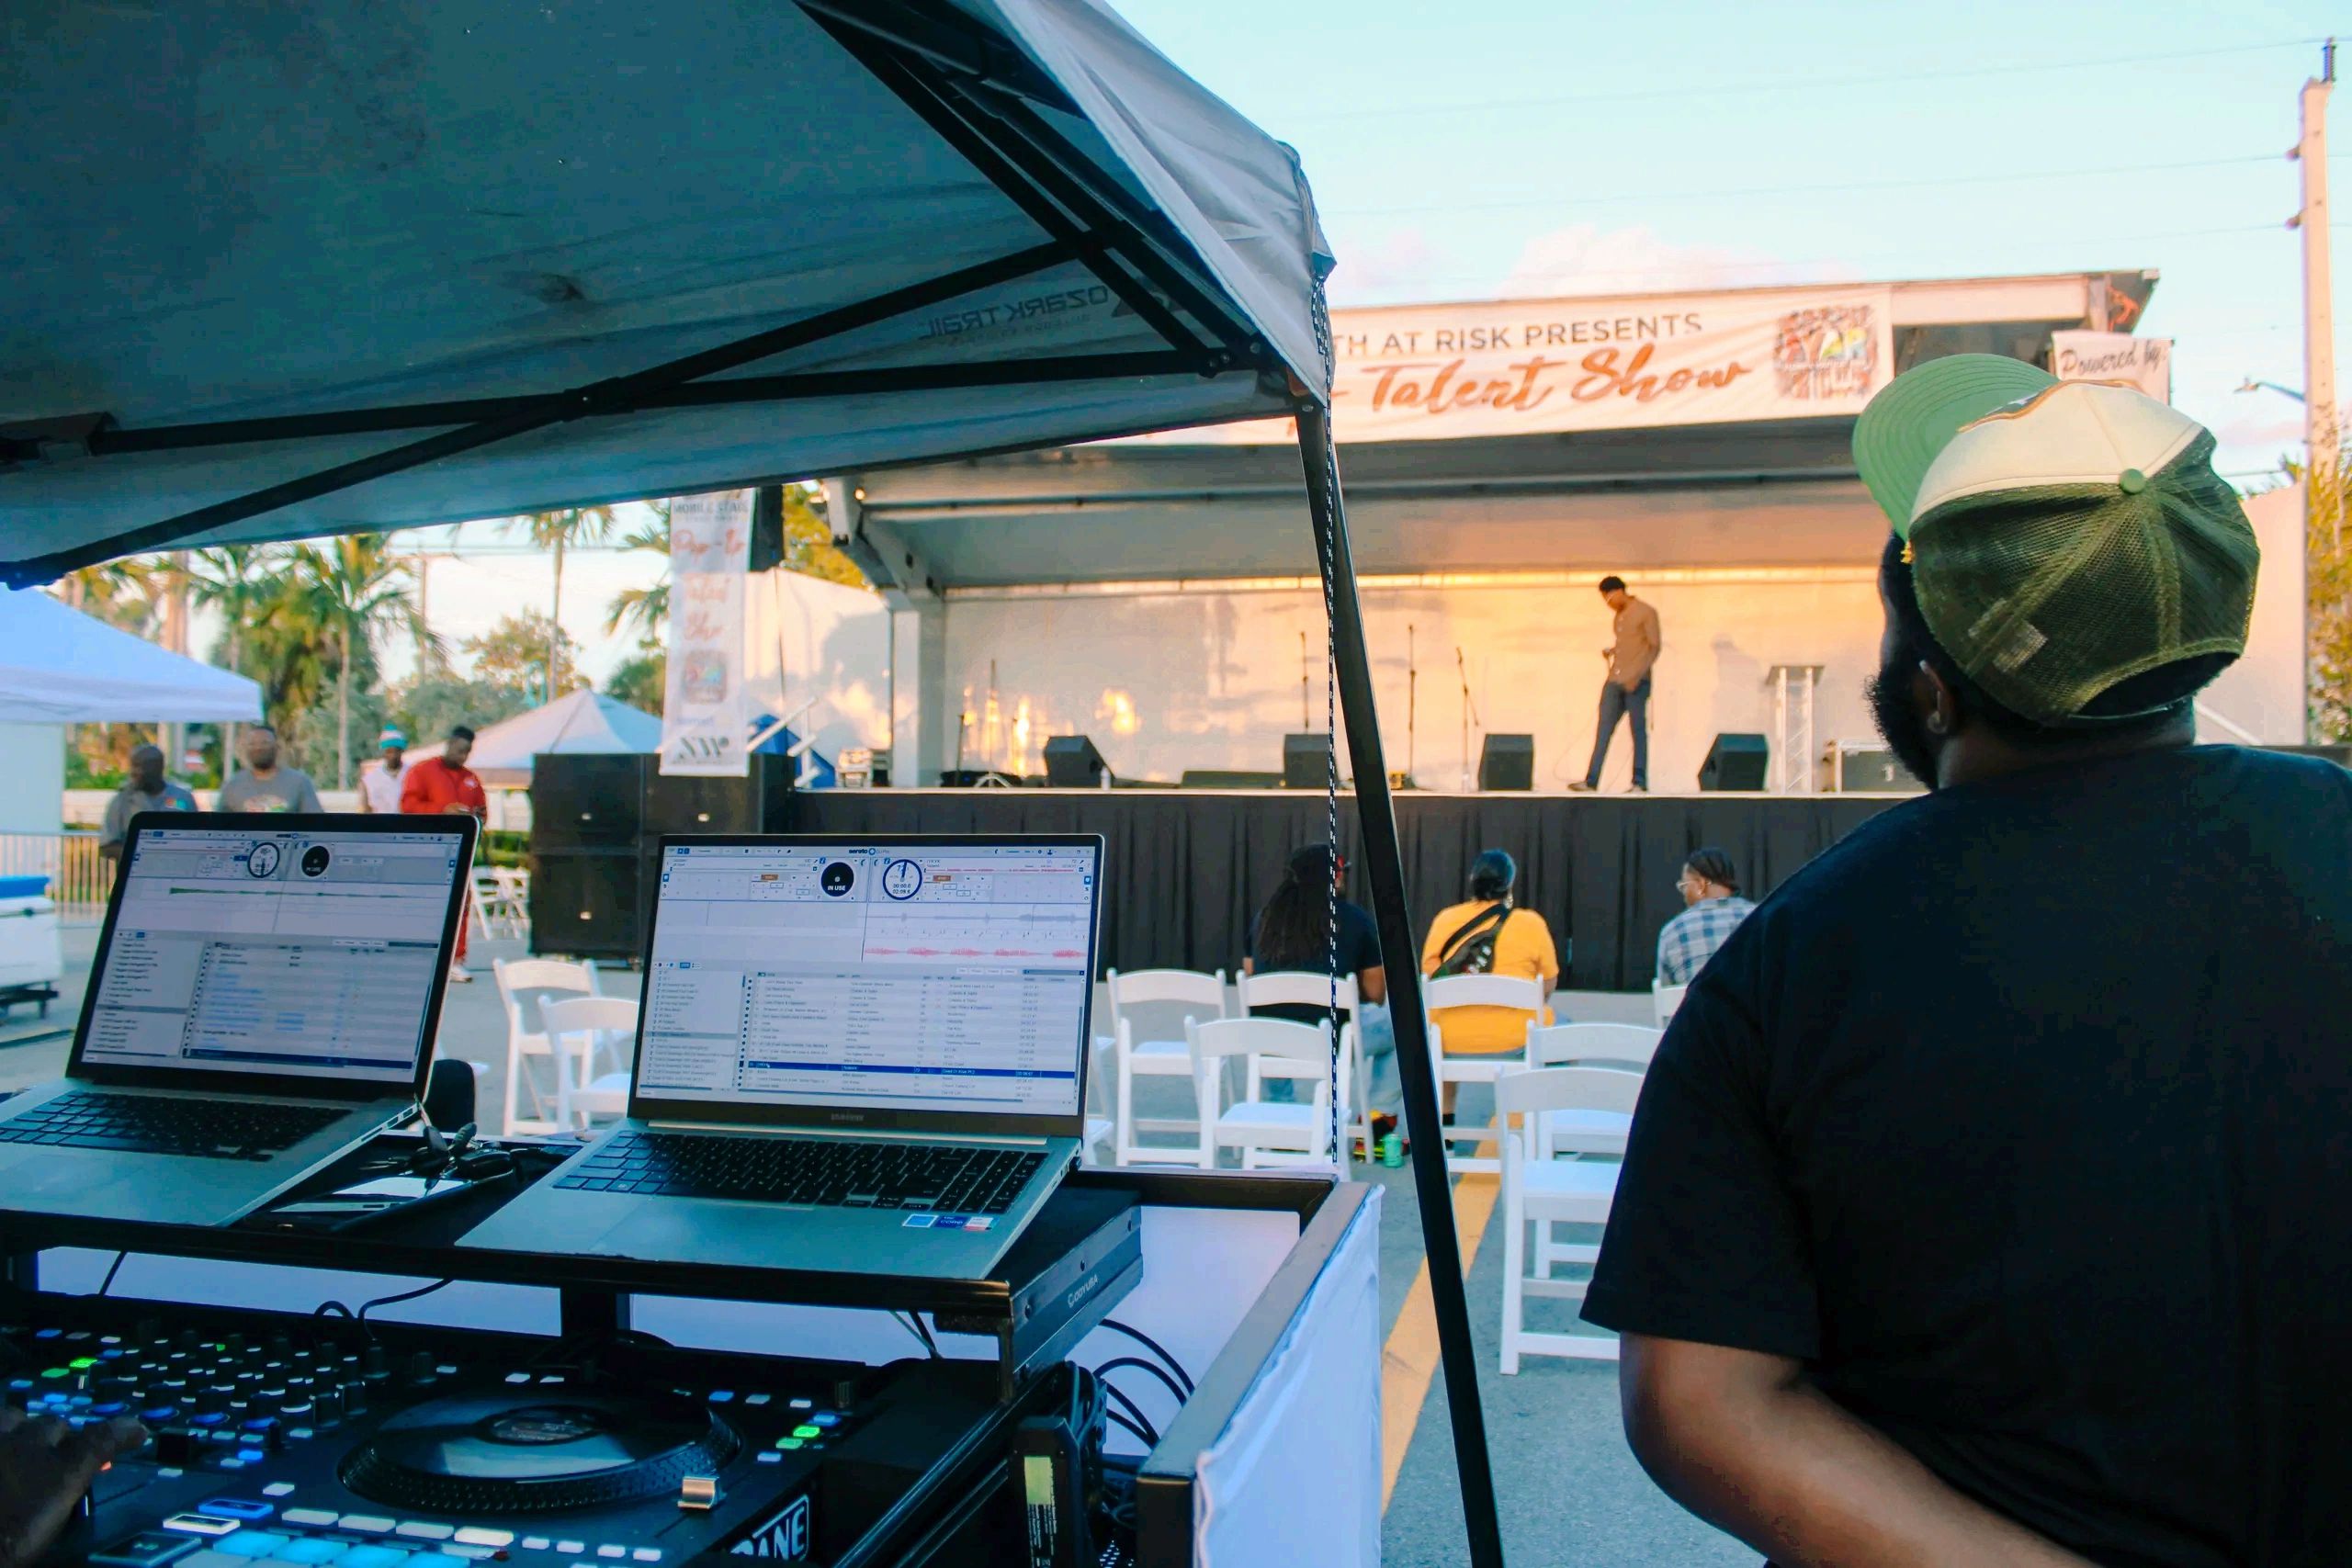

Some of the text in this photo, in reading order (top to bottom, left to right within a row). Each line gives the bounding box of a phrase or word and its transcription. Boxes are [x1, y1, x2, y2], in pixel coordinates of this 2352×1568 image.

[1333, 312, 1703, 355] TH AT RISK PRESENTS
[1361, 343, 1753, 414] Talent Show
[2060, 341, 2138, 378] Powered
